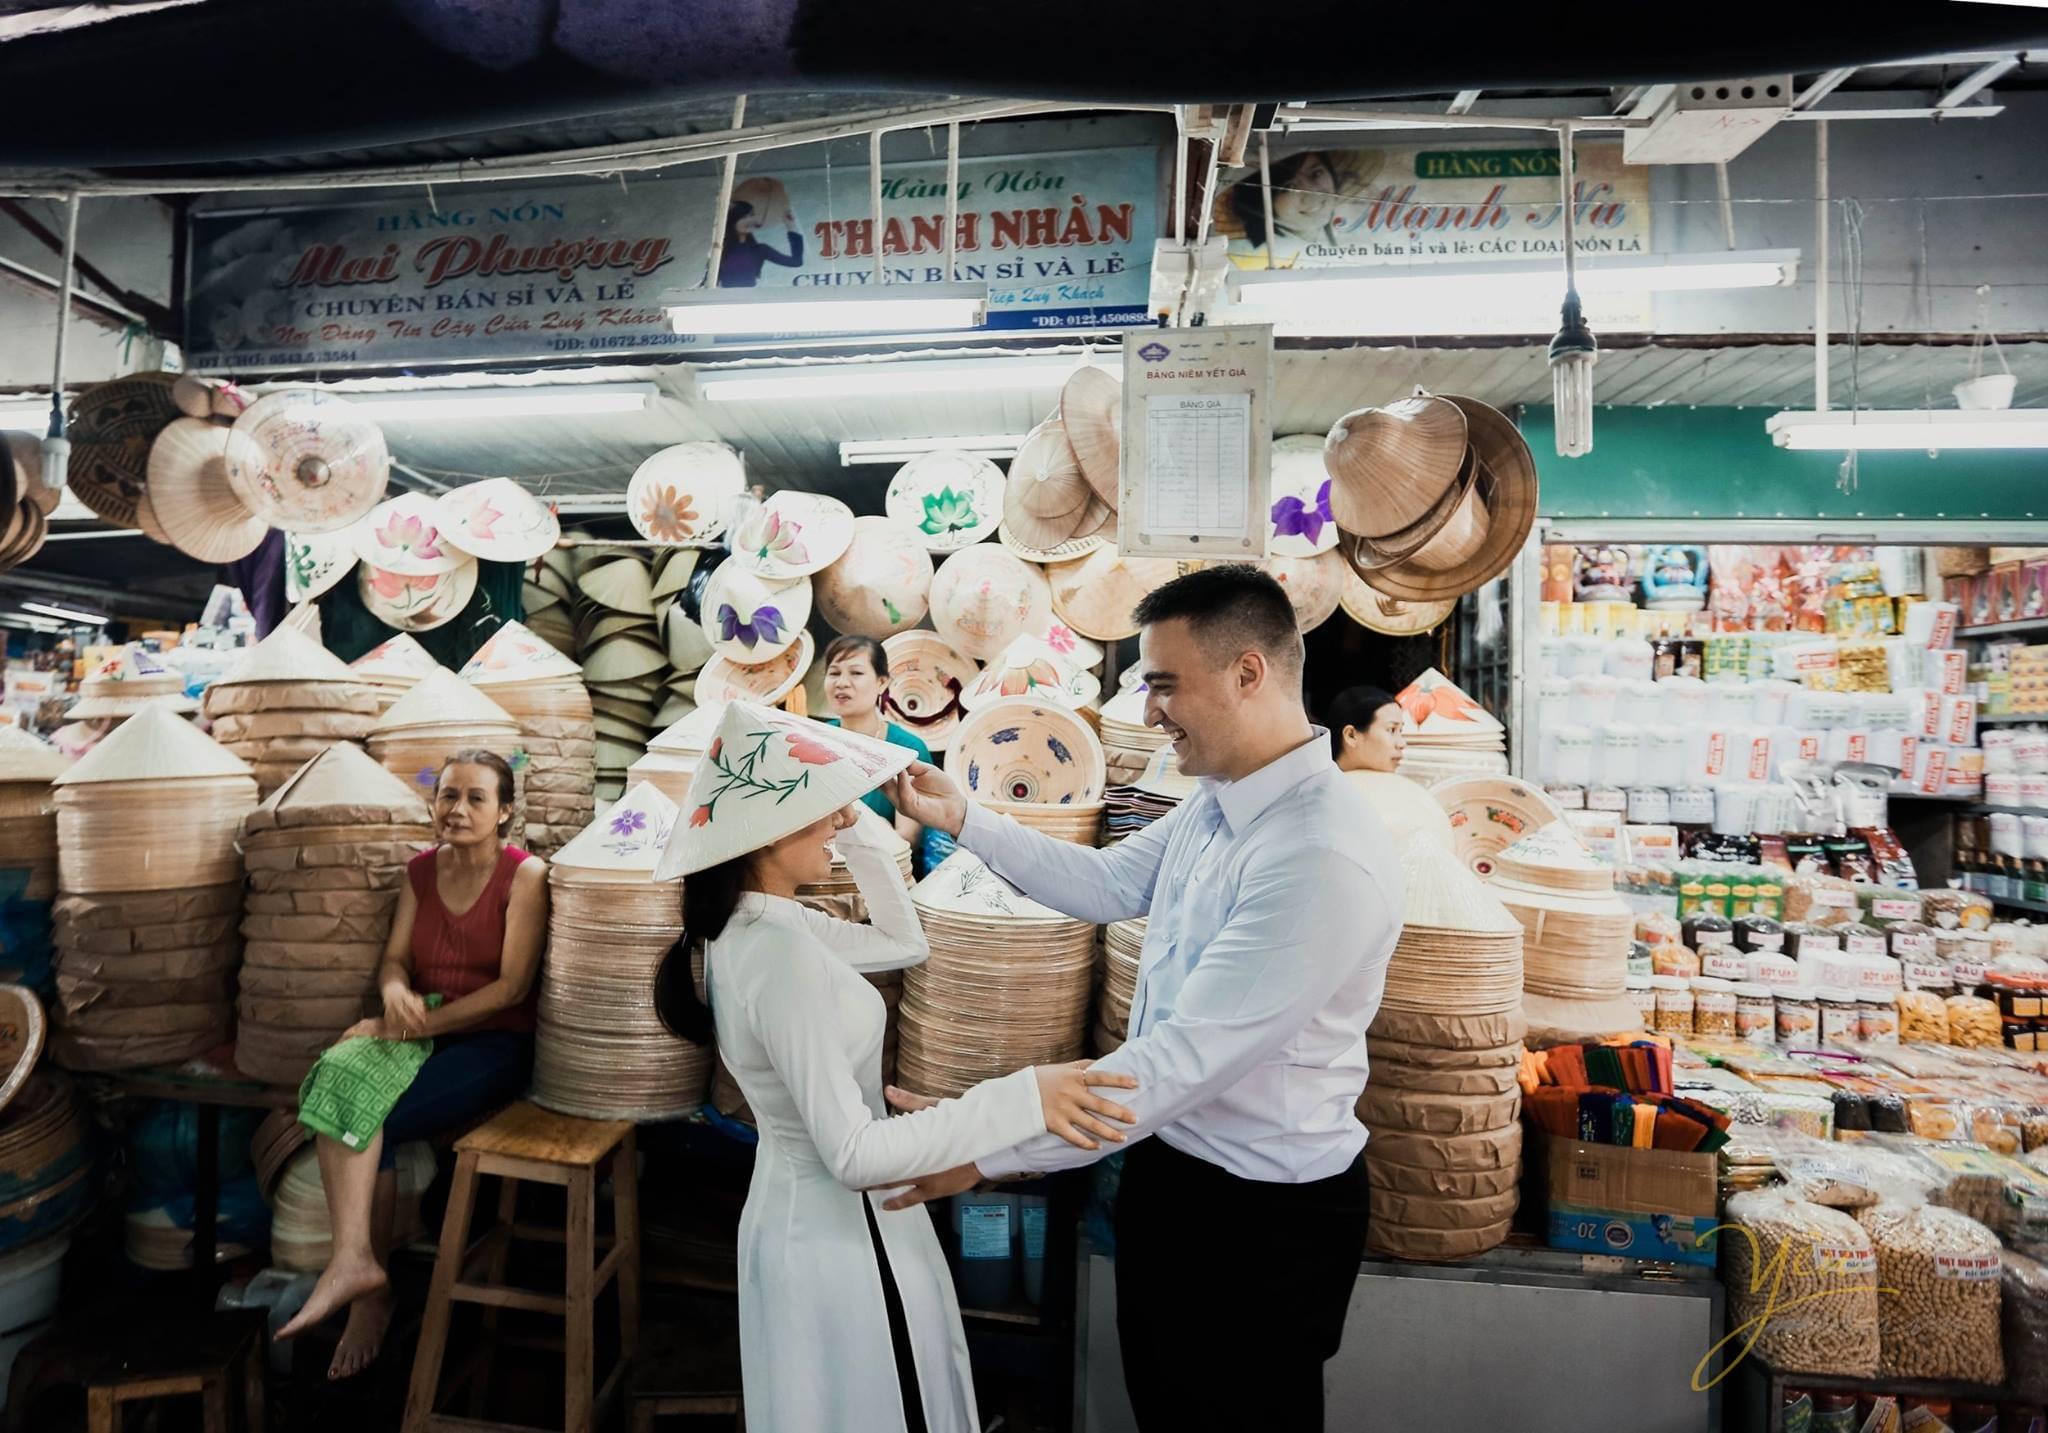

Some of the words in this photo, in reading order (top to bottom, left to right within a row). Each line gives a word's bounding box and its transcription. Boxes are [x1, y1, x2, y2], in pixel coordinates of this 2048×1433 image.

[1427, 155, 1500, 176] HÀNG
[1510, 154, 1563, 175] NÓN
[880, 177, 972, 201] Hàng
[984, 169, 1066, 193] Nón
[376, 208, 476, 232] HÀNG
[489, 202, 566, 224] NÓN
[1333, 183, 1511, 241] Mạnh
[814, 211, 982, 260] THANH
[1305, 241, 1369, 260] Chuyên
[1373, 239, 1406, 256] bán
[1428, 240, 1448, 255] và
[1479, 235, 1518, 253] CÁC
[1574, 235, 1611, 253] NÓN
[275, 241, 401, 288] Mai
[414, 233, 675, 288] Phượng
[1035, 255, 1075, 278] VÀ
[1087, 252, 1126, 274] LẺ
[305, 293, 426, 318] CHUYÊN
[436, 287, 497, 311] BÁN
[545, 281, 585, 304] VÀ
[597, 277, 634, 300] LẺ
